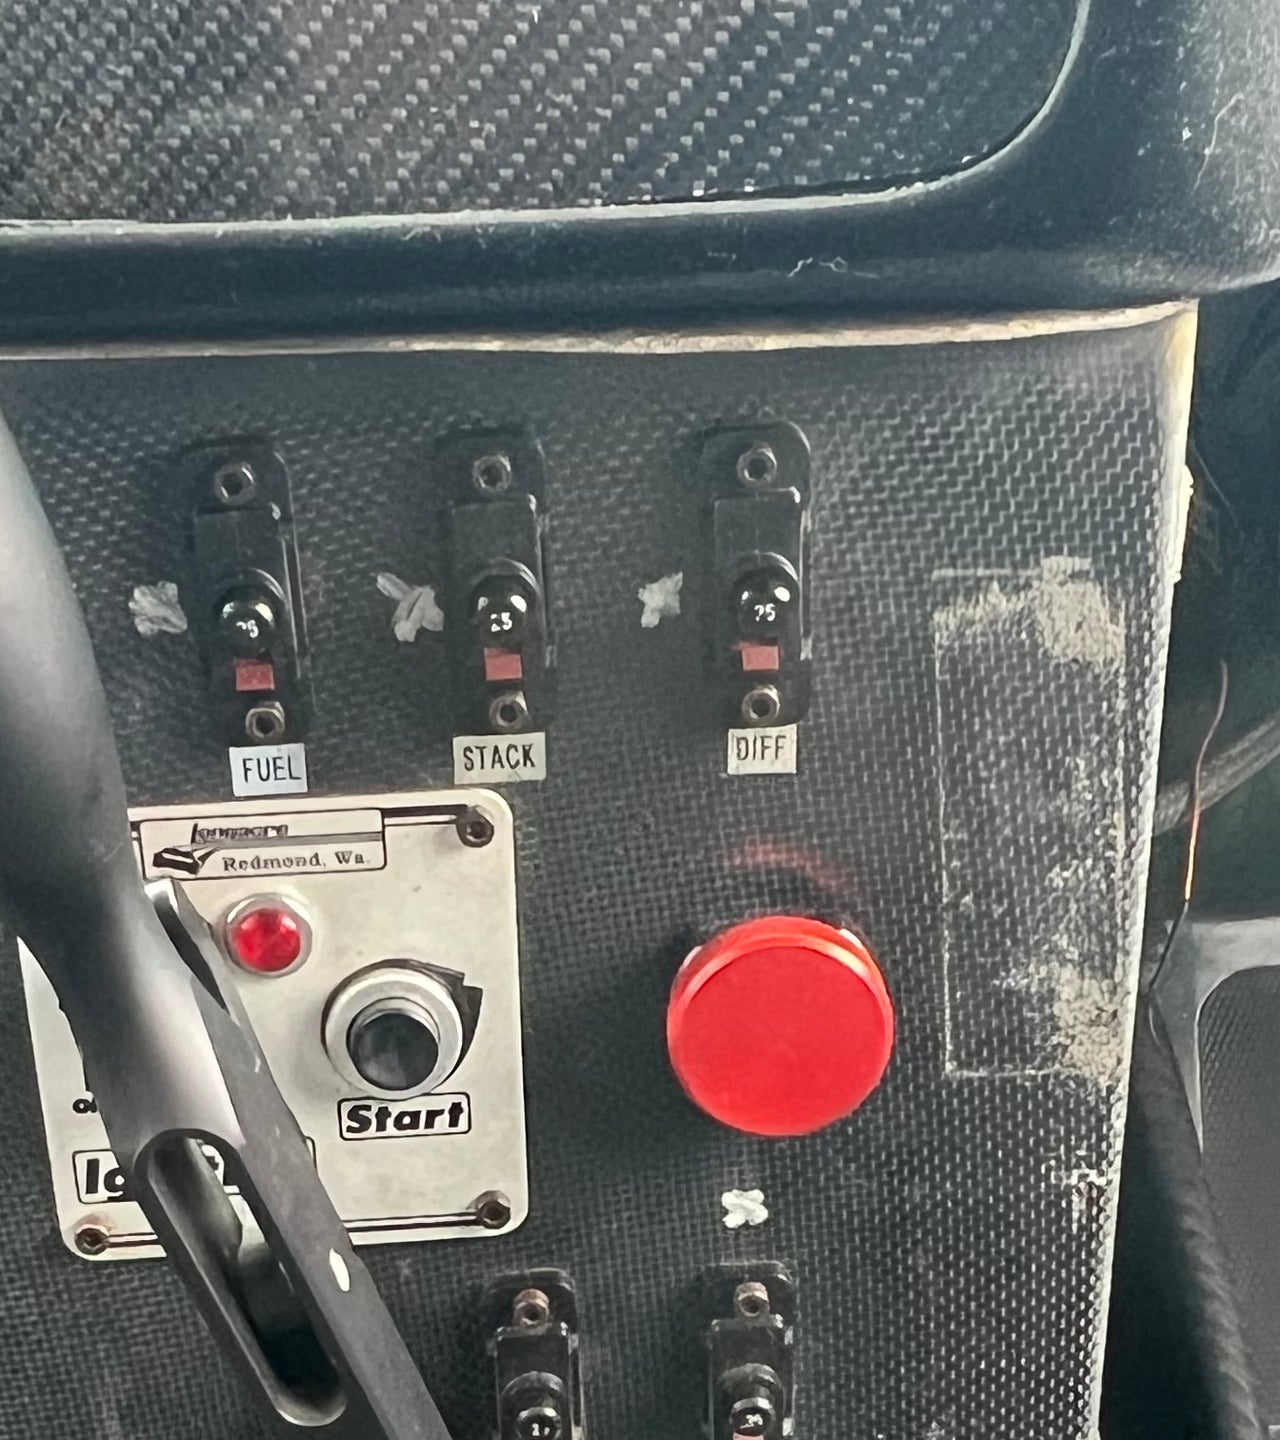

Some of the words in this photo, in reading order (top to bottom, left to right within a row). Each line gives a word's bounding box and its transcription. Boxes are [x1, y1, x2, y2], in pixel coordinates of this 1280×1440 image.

[463, 743, 536, 772] STACK
[735, 733, 787, 761] DIFF
[242, 755, 302, 783] FUEL
[346, 1101, 464, 1134] Start
